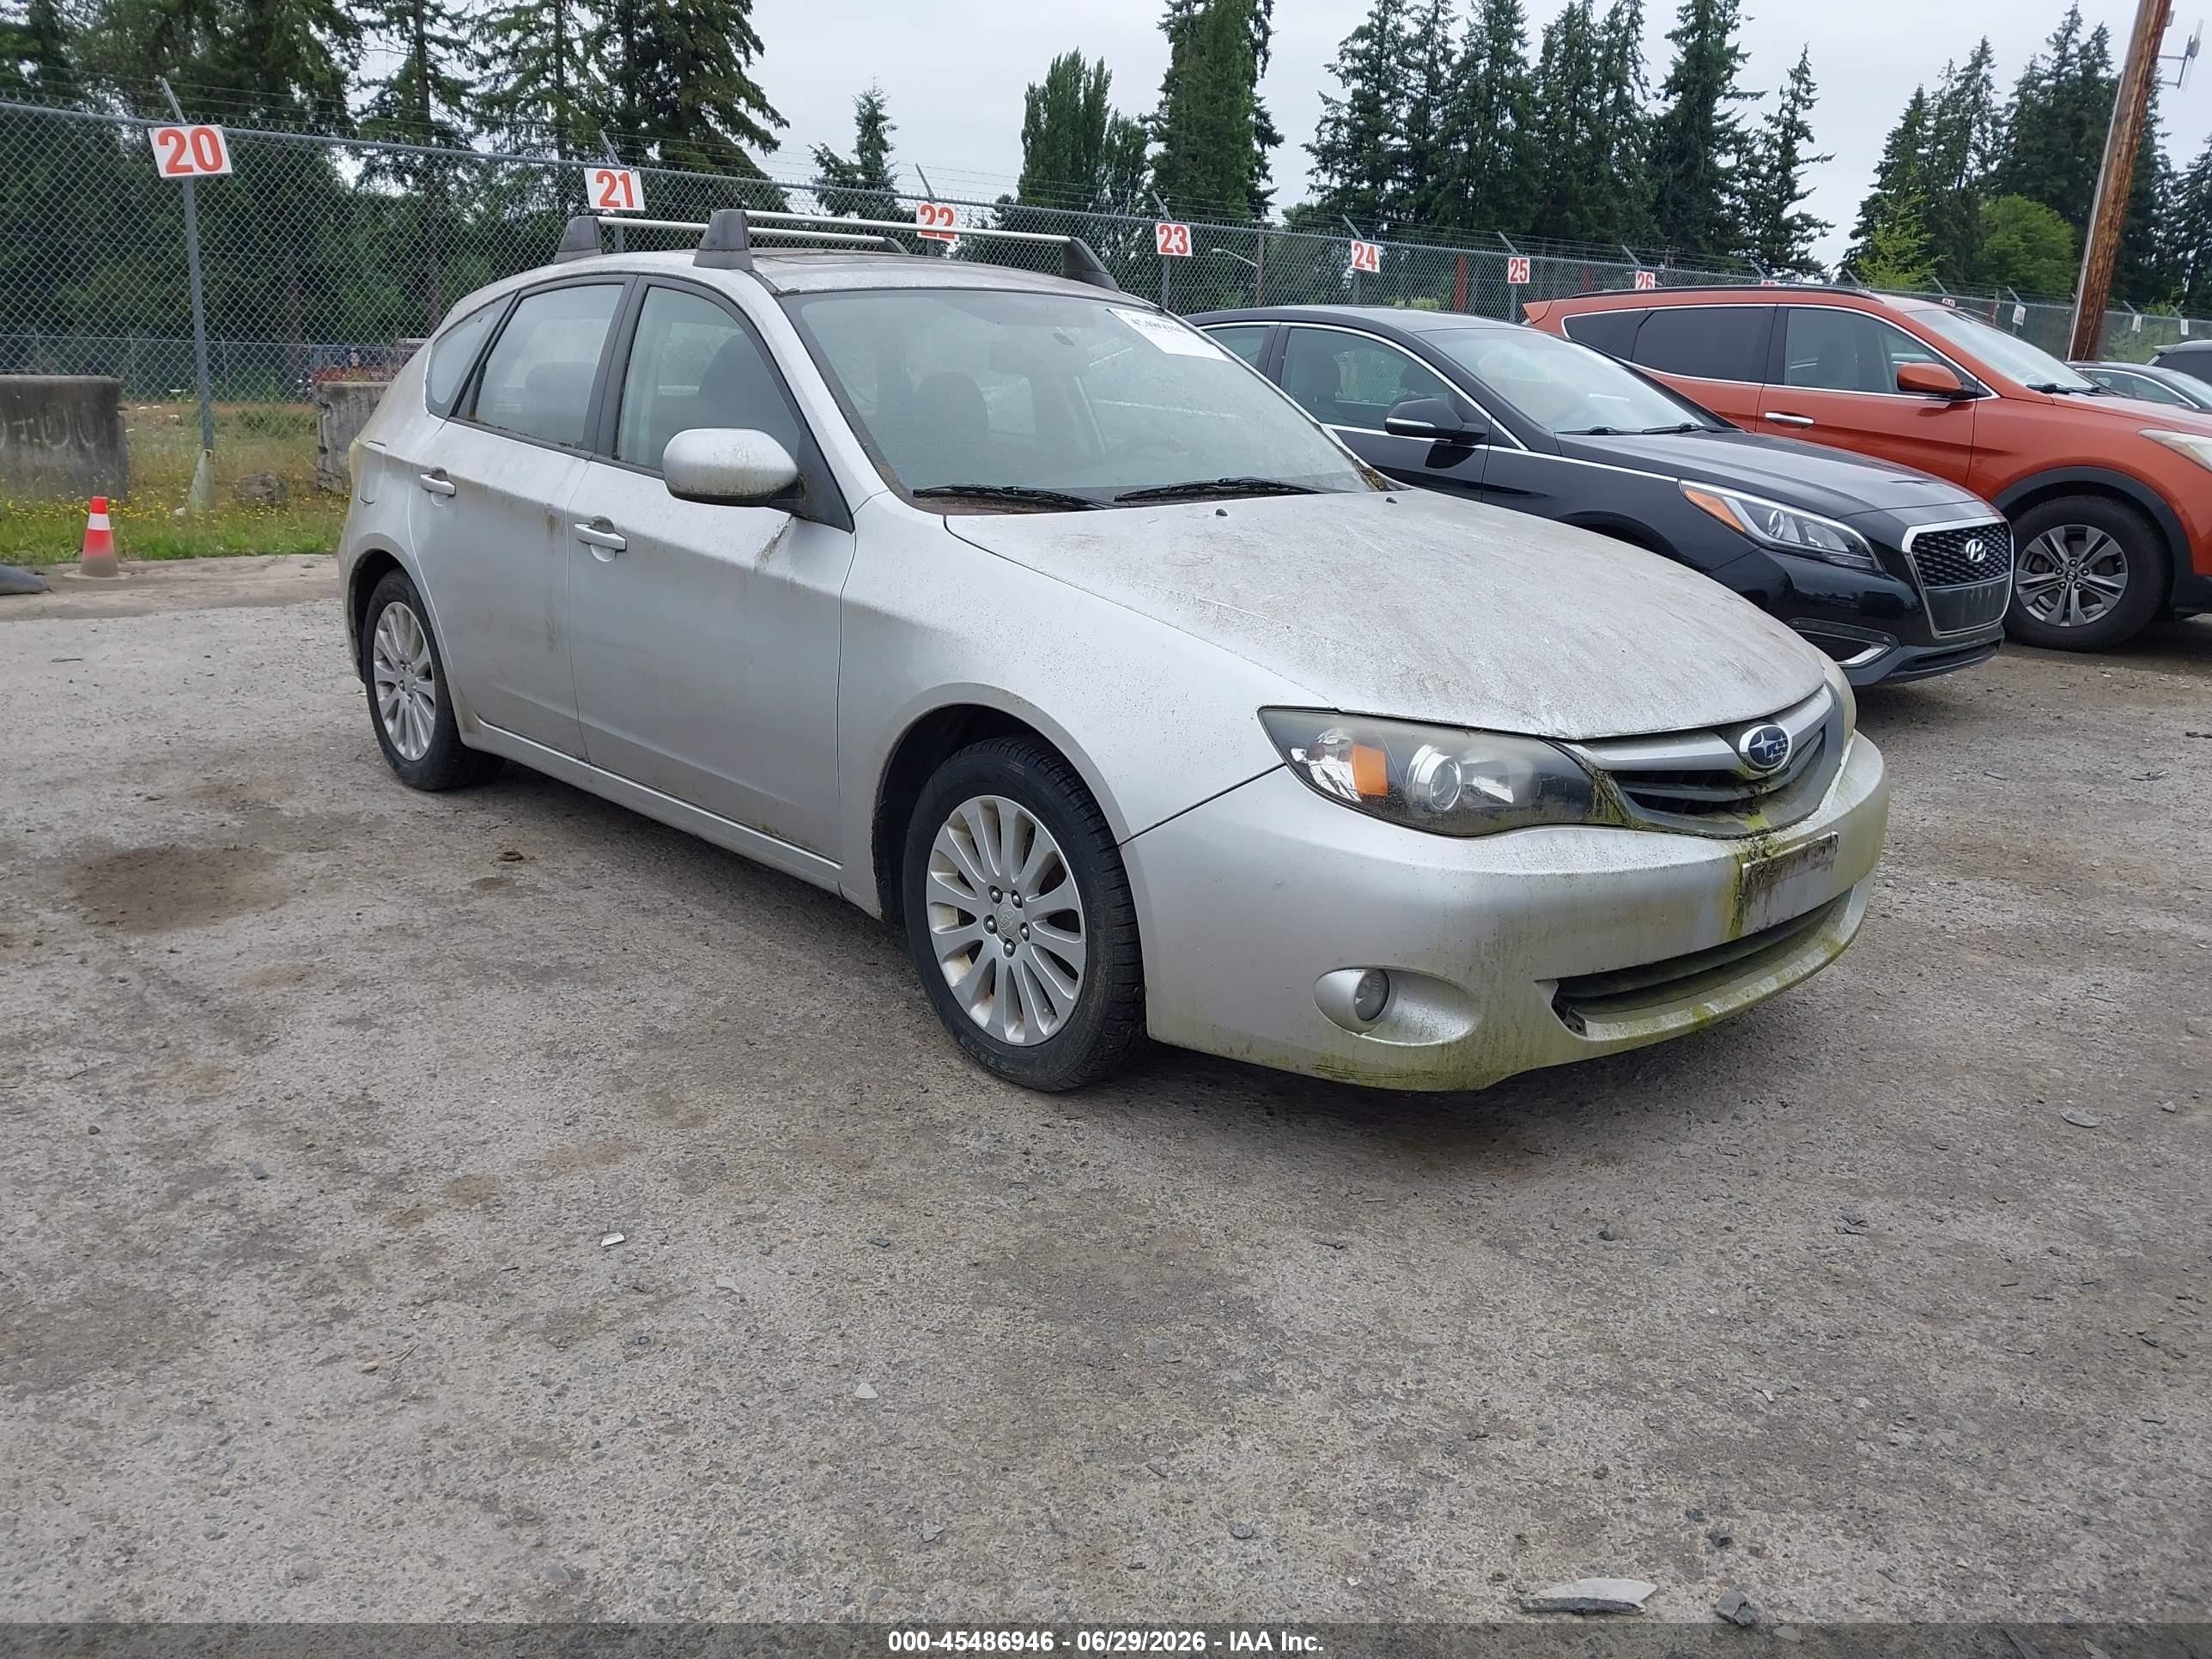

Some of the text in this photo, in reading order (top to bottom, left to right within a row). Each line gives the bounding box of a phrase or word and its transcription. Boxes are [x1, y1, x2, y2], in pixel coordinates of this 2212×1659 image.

[157, 126, 223, 174] 20
[595, 169, 635, 208] 21
[920, 204, 955, 239] 22
[1158, 224, 1188, 254] 23
[1353, 243, 1377, 270] 24
[1509, 258, 1528, 283] 25
[1638, 273, 1654, 289] 26
